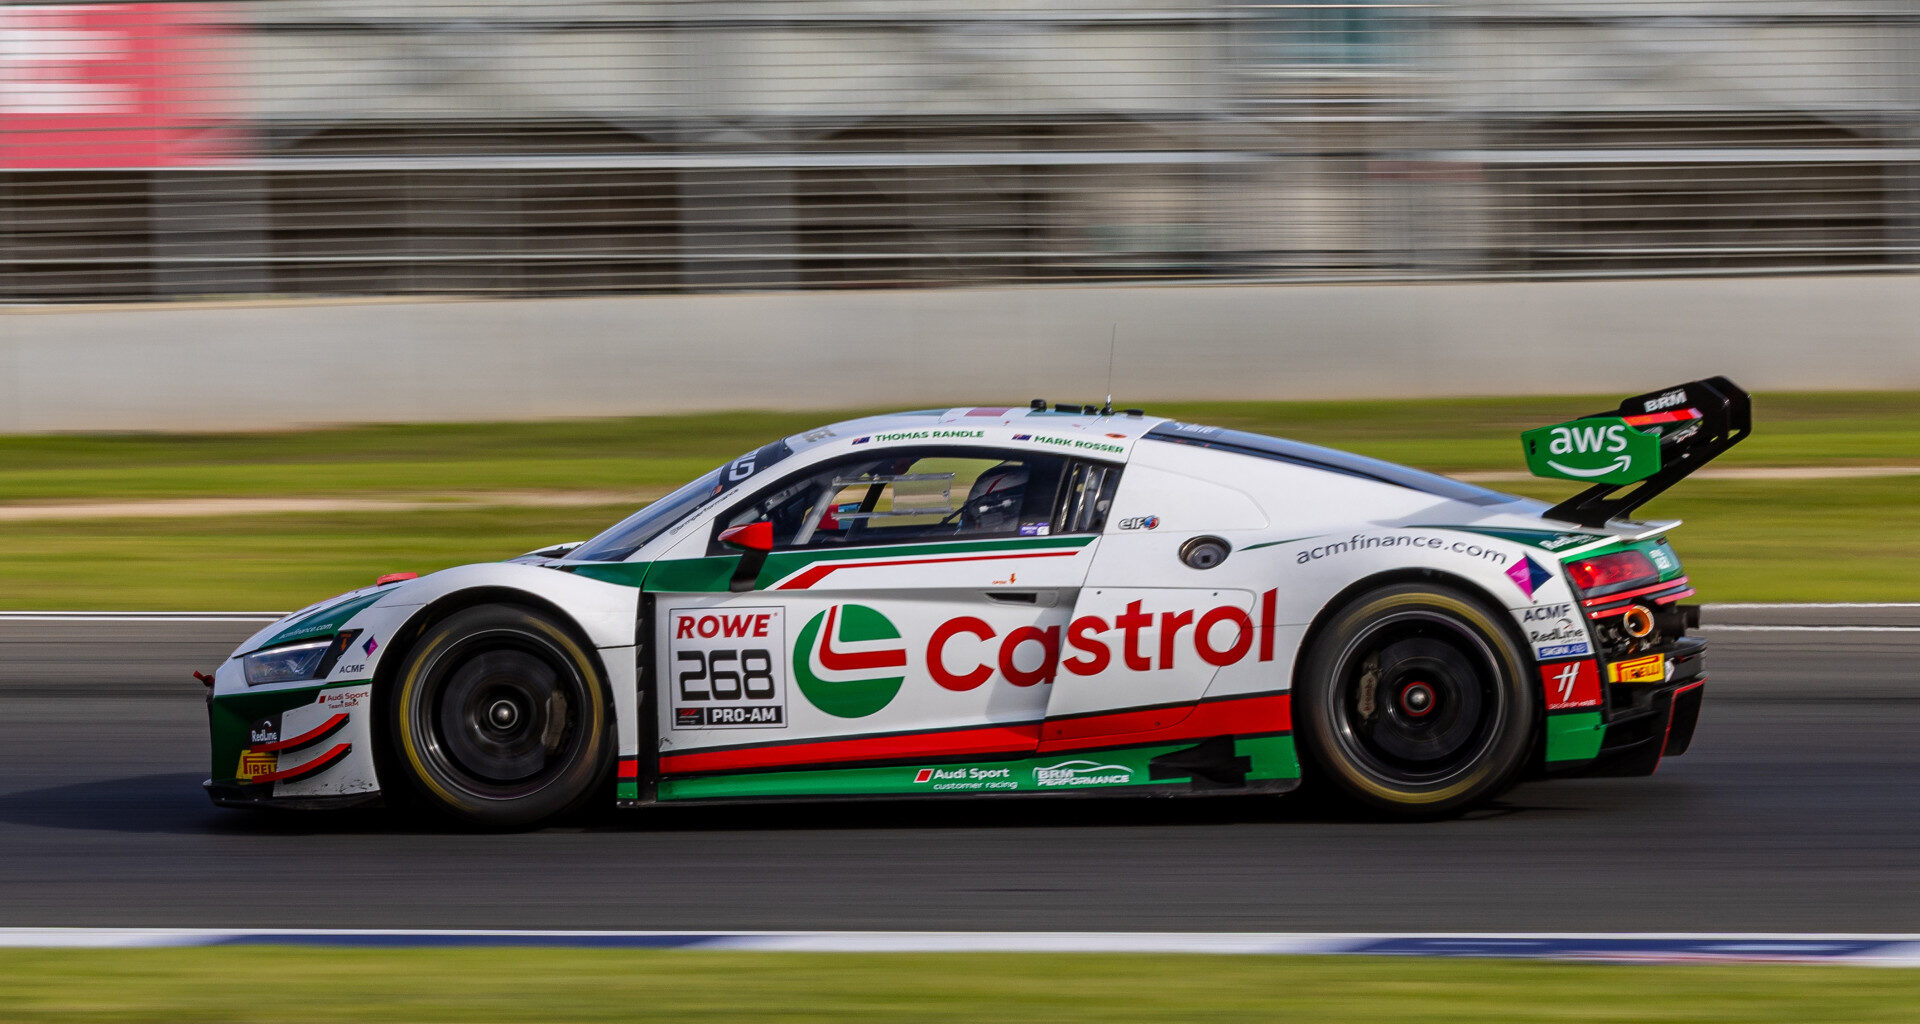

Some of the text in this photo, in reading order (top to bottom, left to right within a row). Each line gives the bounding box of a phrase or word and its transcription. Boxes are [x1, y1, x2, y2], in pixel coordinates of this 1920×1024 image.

[1644, 391, 1687, 413] BRM
[874, 429, 985, 442] THOMAS RANDLE
[1549, 424, 1628, 455] aws
[1033, 434, 1125, 454] MARK ROSSER
[1118, 516, 1146, 530] elf
[1296, 533, 1508, 565] acmfinance.com
[1523, 603, 1572, 623] ACMF
[676, 613, 772, 640] ROWE
[926, 586, 1279, 692] Castrol
[338, 664, 366, 674] ACMF
[677, 648, 776, 702] 268
[327, 691, 370, 702] Audi Sport
[712, 707, 776, 723] PRO-AM
[251, 729, 278, 743] RedLine
[933, 766, 1010, 780] Audi Sport
[1037, 768, 1074, 780] BRM
[1037, 774, 1130, 787] PERFORMANCE
[933, 779, 1018, 791] customer racing
